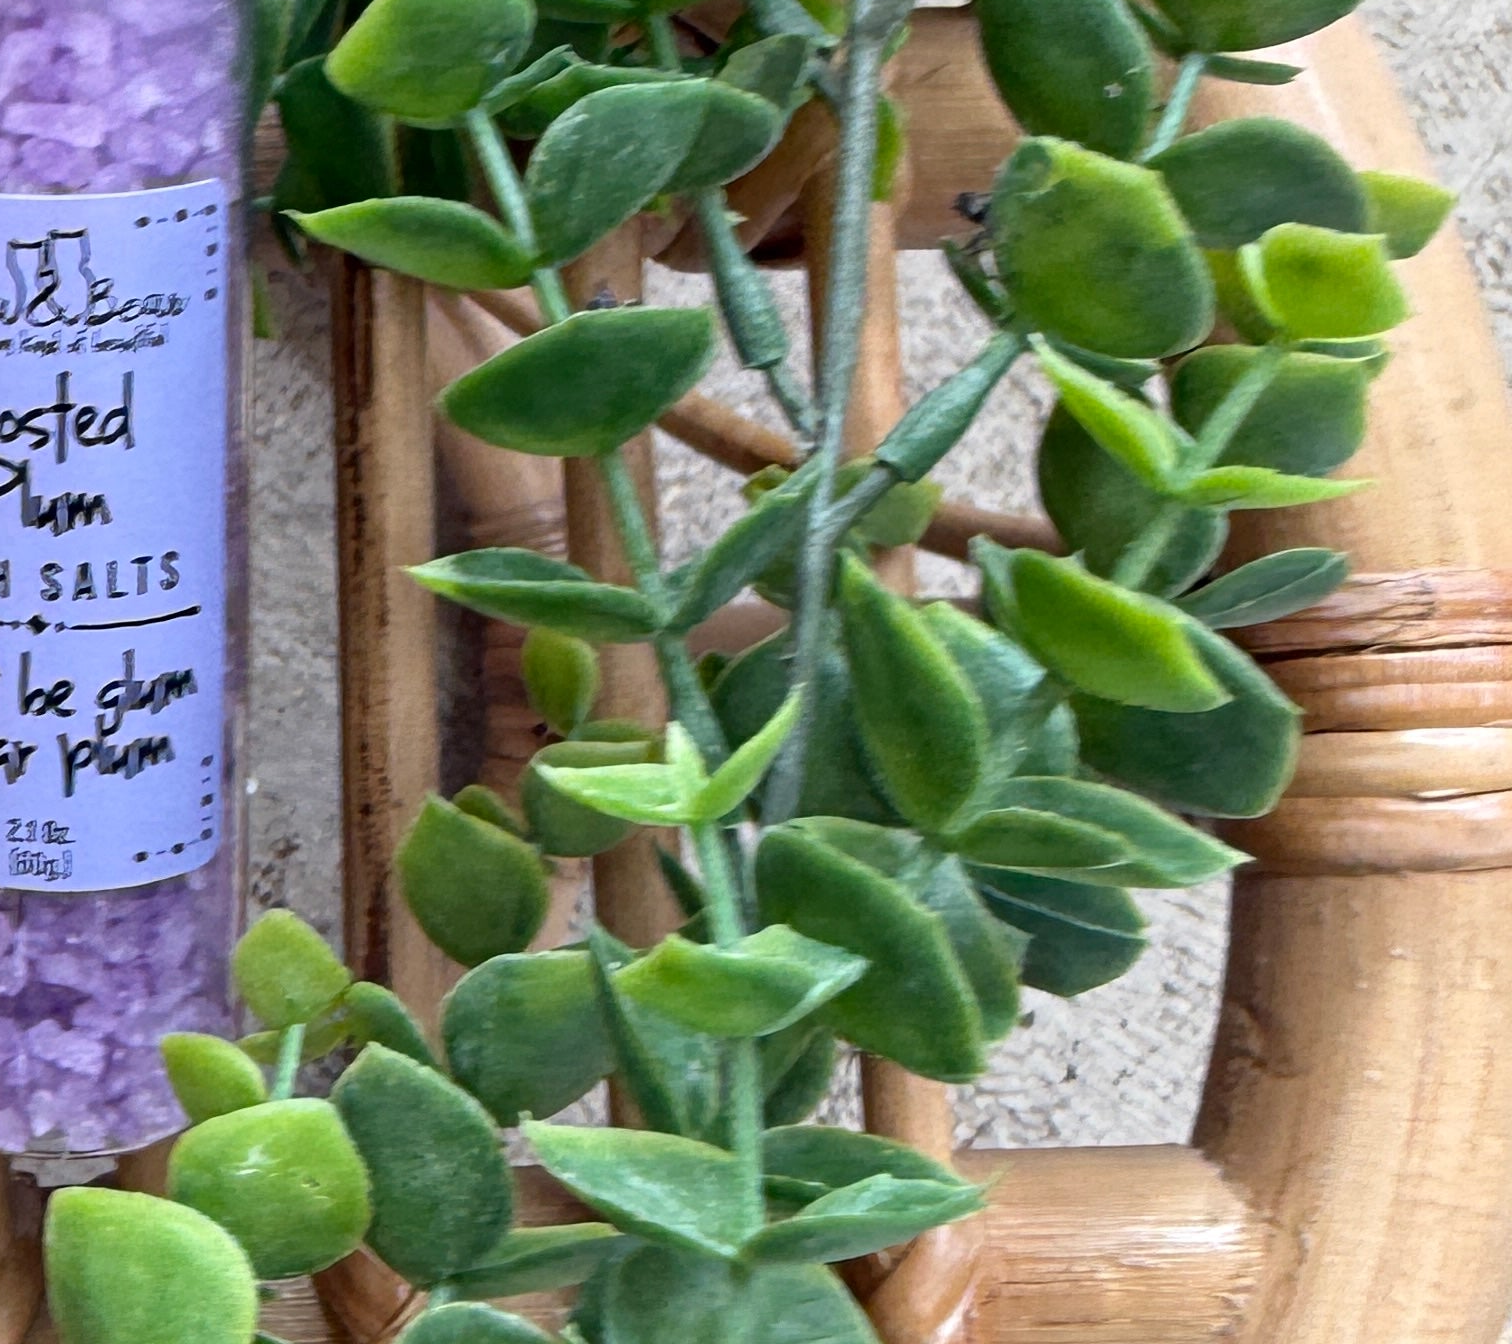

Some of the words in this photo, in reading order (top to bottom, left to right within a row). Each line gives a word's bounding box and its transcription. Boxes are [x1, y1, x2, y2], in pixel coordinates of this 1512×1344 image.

[39, 551, 181, 602] SALTS
[18, 650, 77, 718] be
[94, 648, 199, 736] glum
[55, 722, 177, 798] plum
